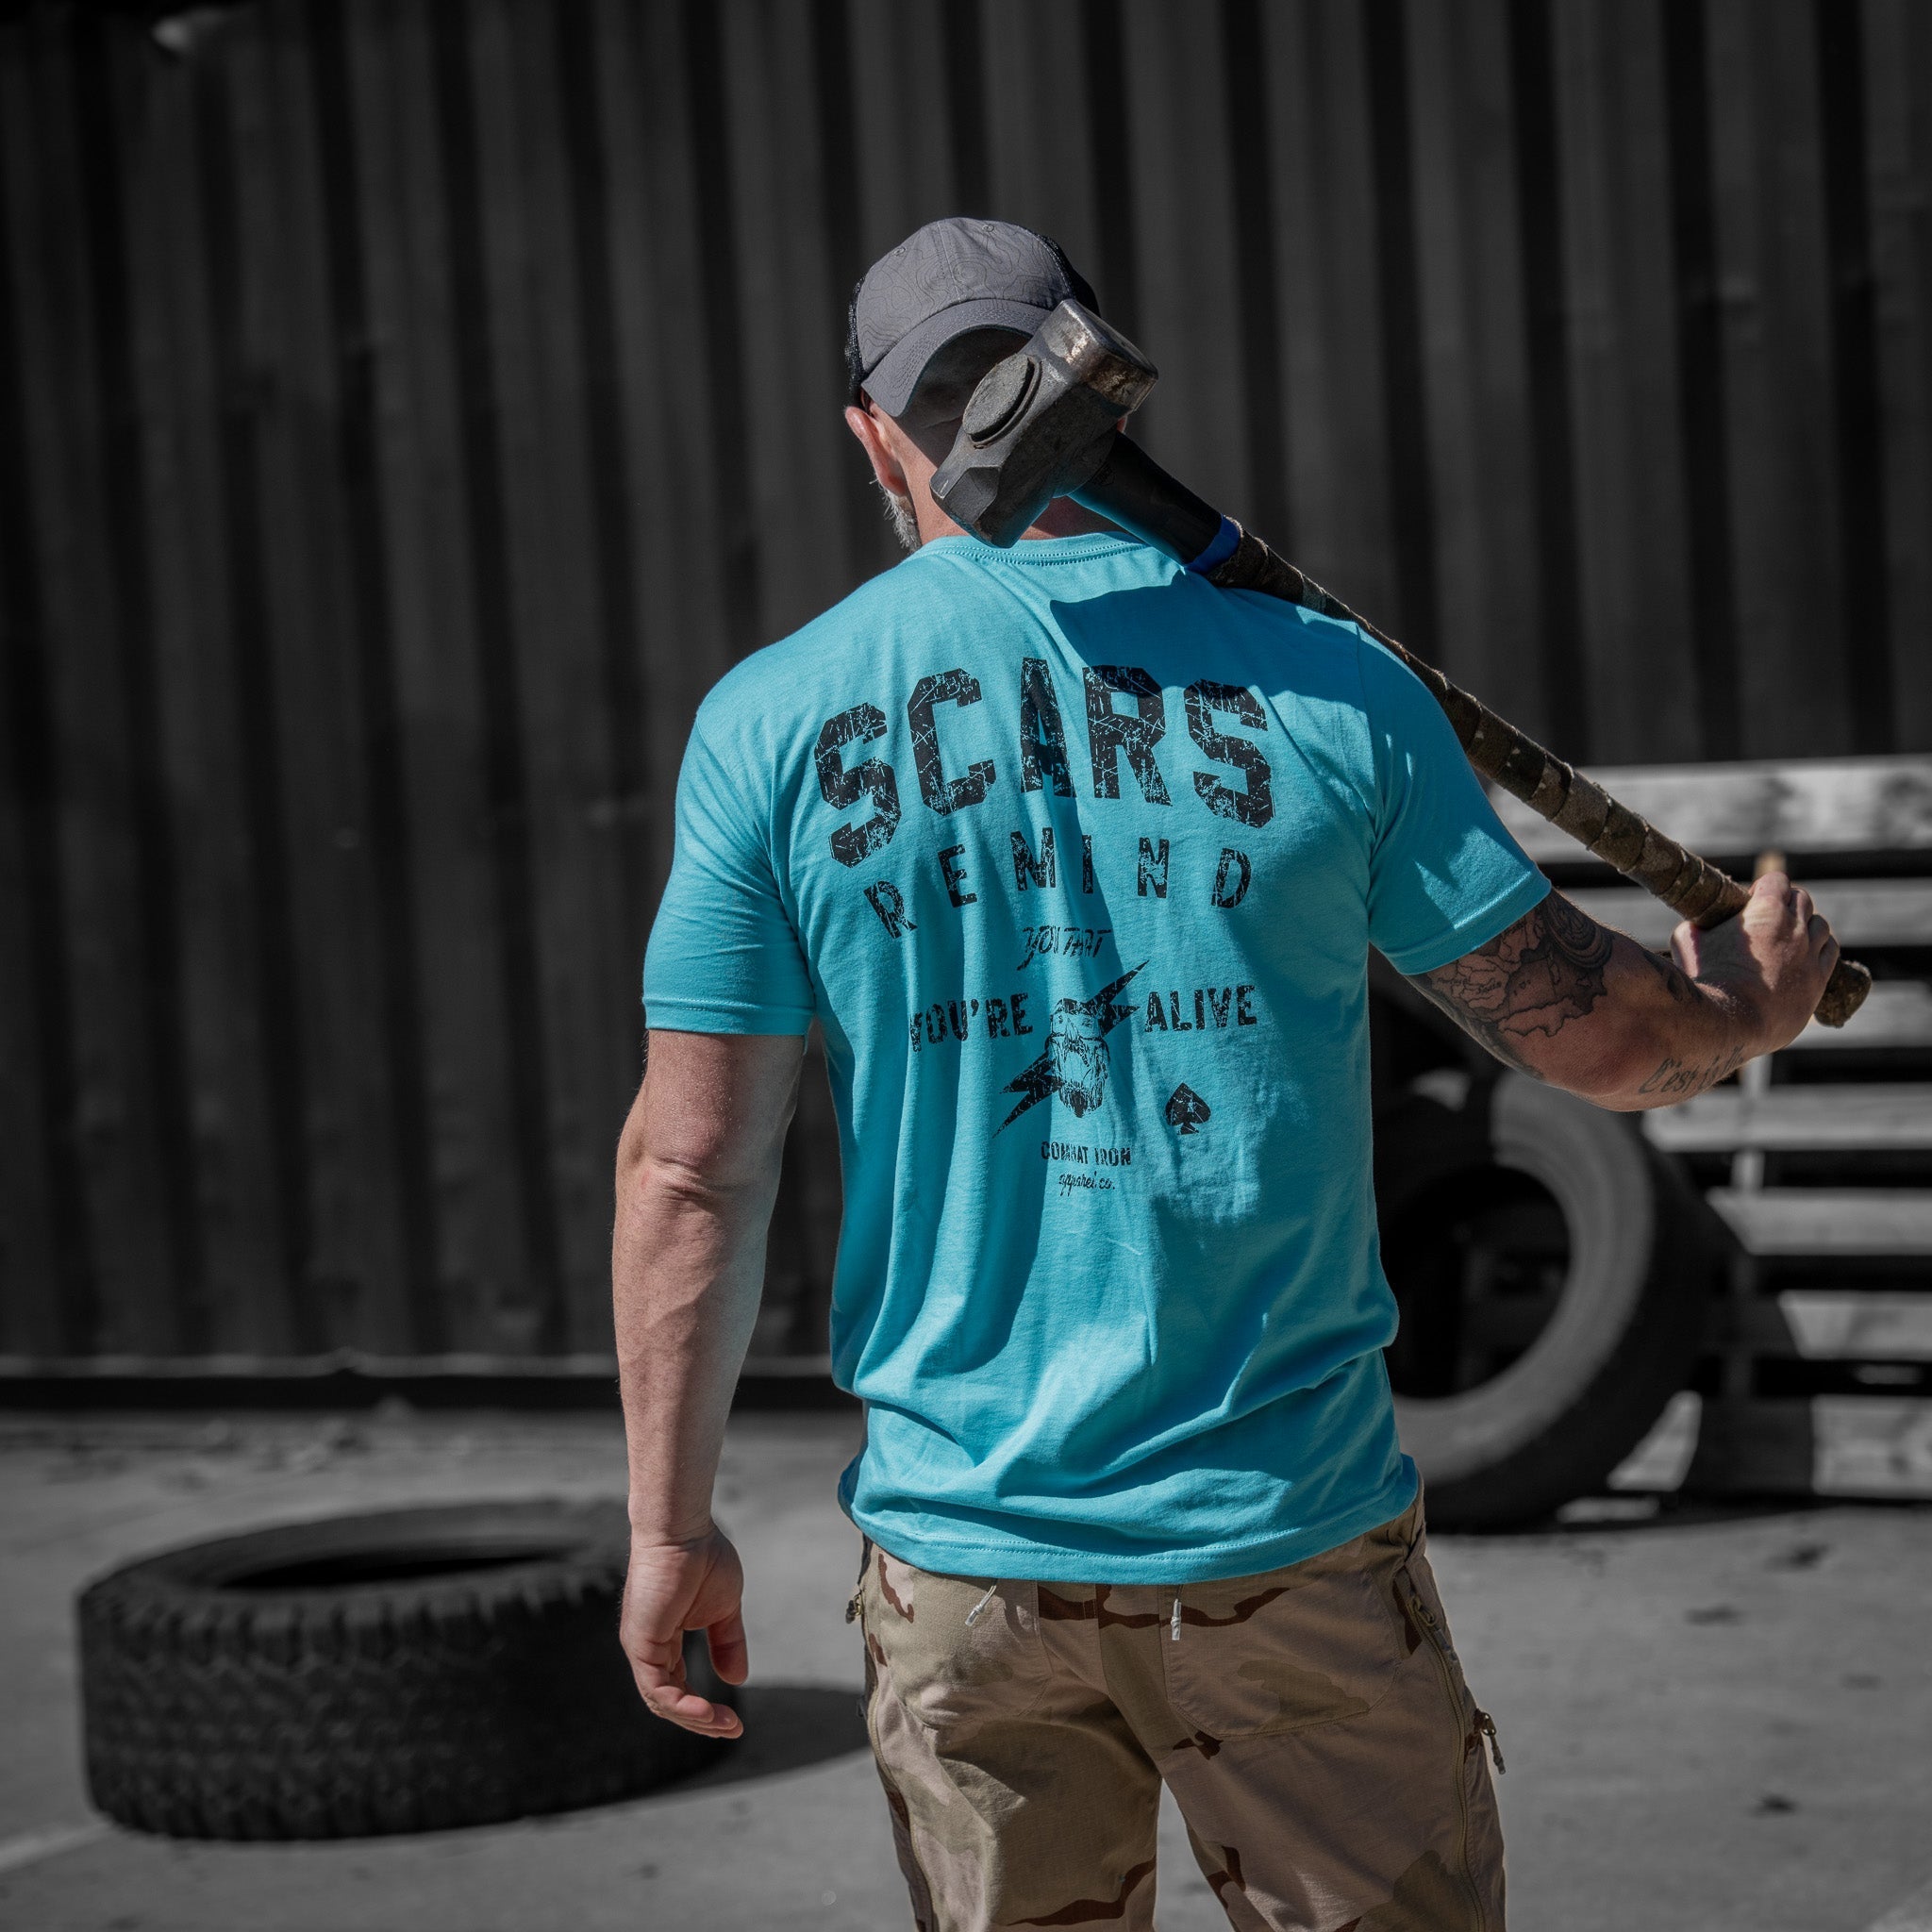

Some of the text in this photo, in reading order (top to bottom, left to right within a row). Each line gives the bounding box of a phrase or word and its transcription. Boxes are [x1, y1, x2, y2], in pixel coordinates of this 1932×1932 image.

[813, 657, 1276, 869] SCARS
[863, 827, 1252, 940] REMIND
[909, 985, 1257, 1052] YOU'RE ALIVE
[1094, 1147, 1131, 1167] IRON
